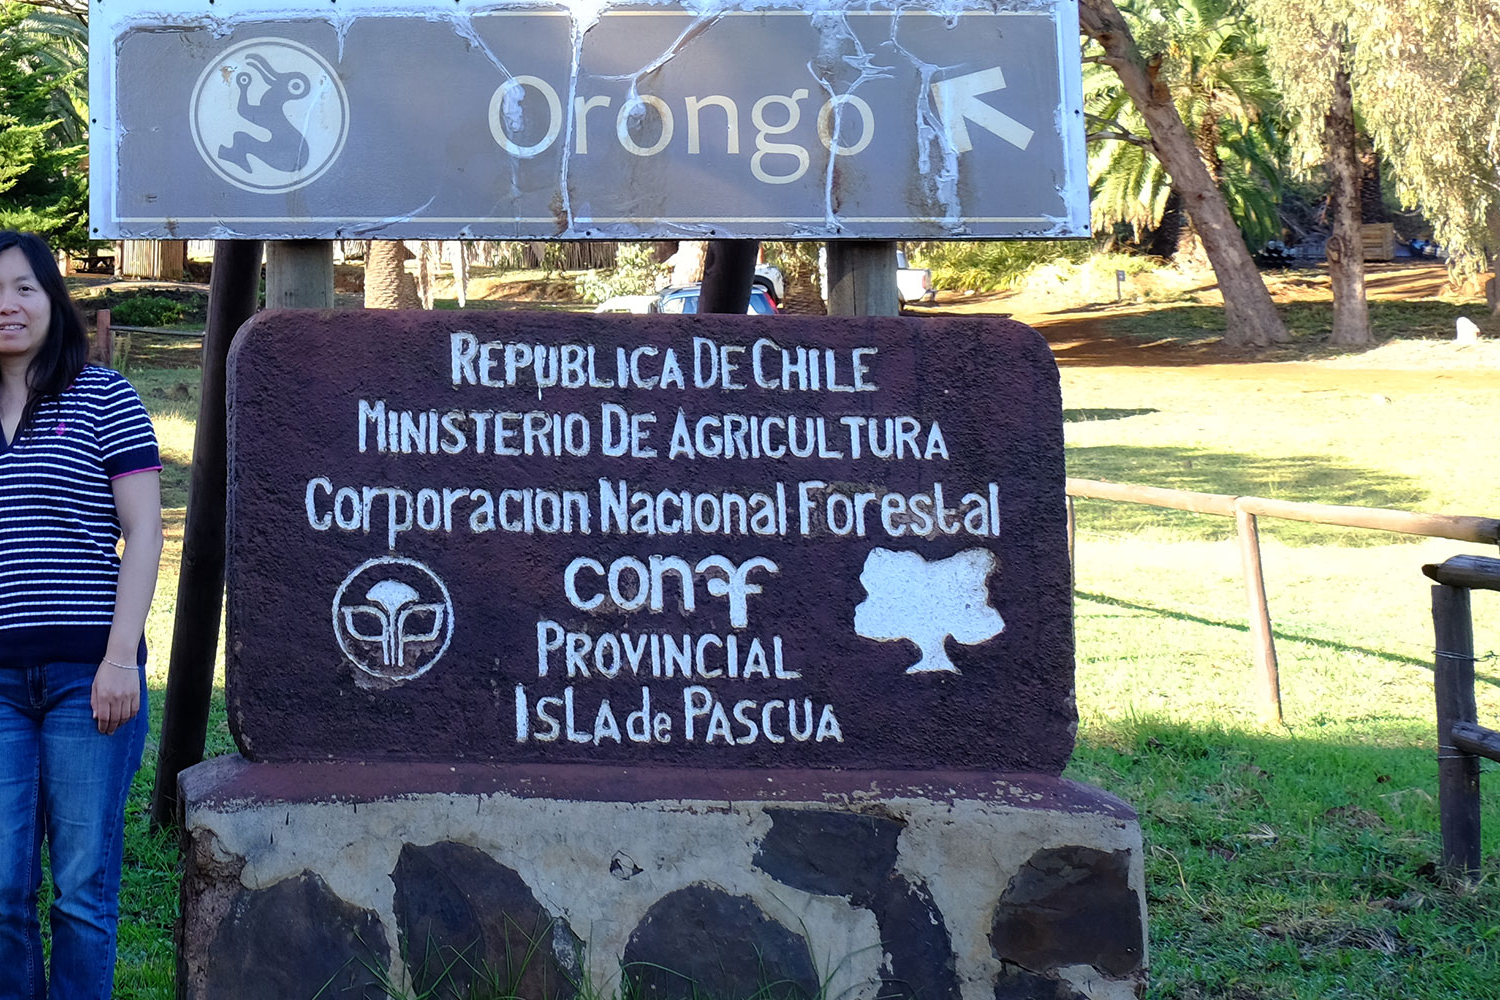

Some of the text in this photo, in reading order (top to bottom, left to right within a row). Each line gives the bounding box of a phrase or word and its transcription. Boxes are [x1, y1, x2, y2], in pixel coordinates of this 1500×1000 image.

[488, 75, 875, 184] Orongo
[450, 331, 879, 392] REPUBLICA DE CHILE
[358, 399, 949, 460] MINISTERIO DE AGRICULTURA
[305, 476, 1001, 550] Corporacion Nacional Forestal
[537, 620, 802, 679] PROVINCIAL
[626, 686, 671, 743] de
[683, 685, 844, 745] PASCUA
